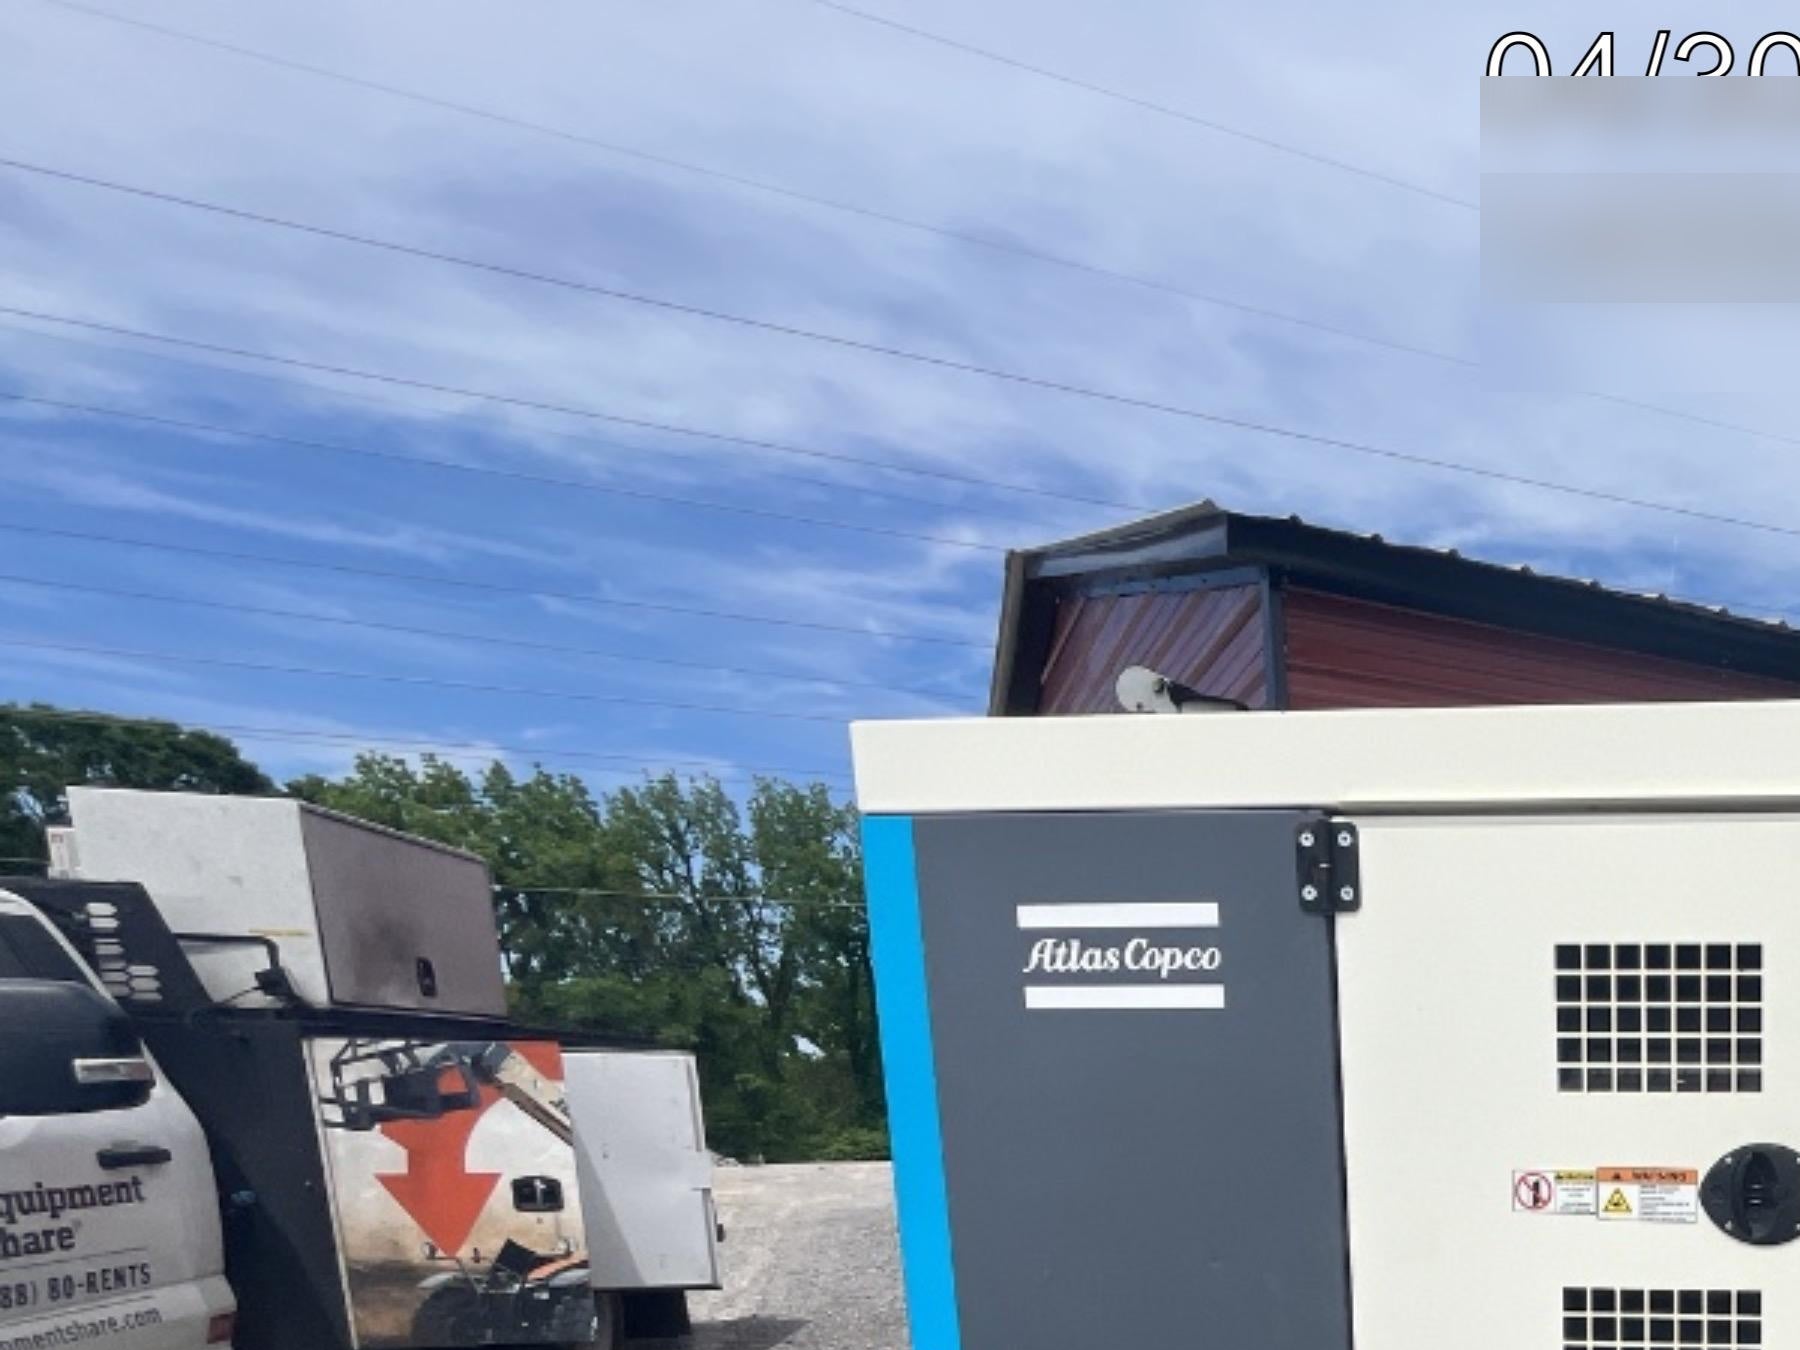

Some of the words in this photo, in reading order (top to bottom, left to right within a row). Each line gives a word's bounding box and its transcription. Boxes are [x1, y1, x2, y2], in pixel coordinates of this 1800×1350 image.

[1022, 937, 1120, 972] Atlas
[1124, 937, 1222, 979] Copco
[48, 1262, 151, 1301] 80-RENTS
